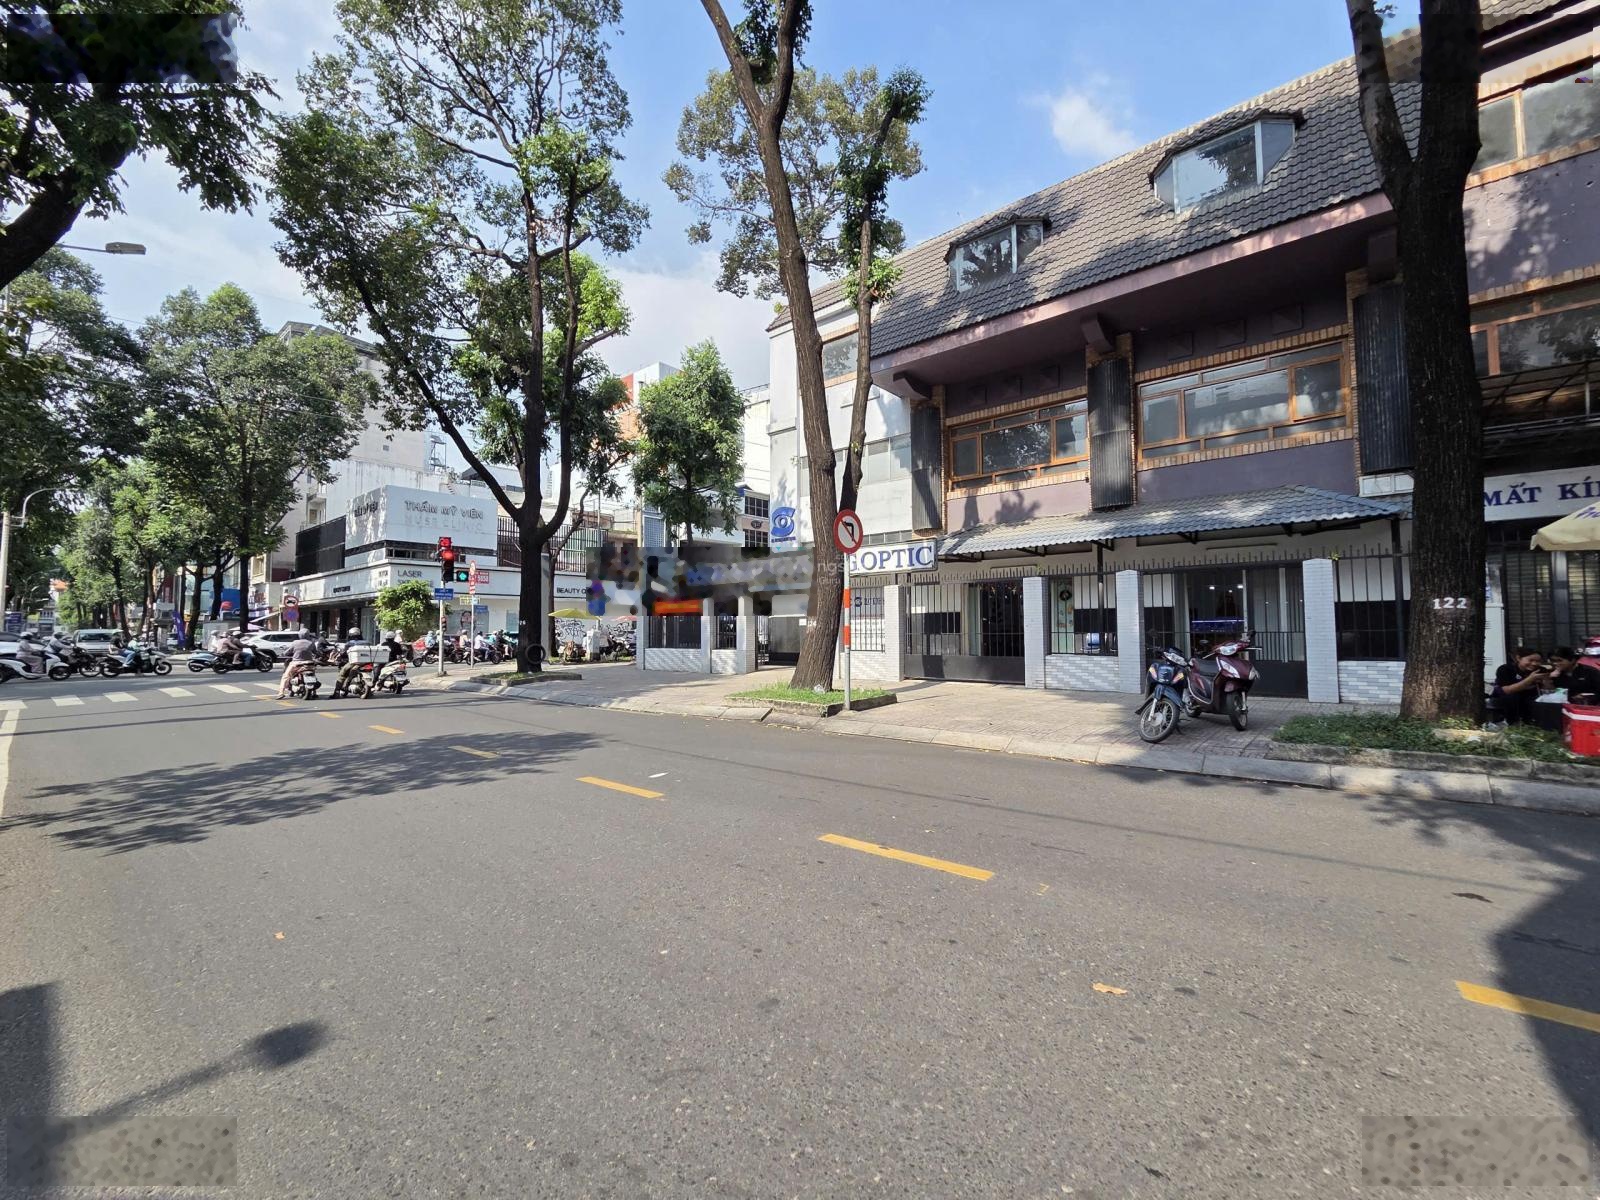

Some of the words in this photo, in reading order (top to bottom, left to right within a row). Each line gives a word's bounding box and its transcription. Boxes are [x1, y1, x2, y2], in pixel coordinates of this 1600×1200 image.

[1557, 475, 1600, 500] KÍ
[397, 570, 423, 578] LASER
[556, 586, 580, 594] BEAUTY
[1433, 597, 1467, 609] 122
